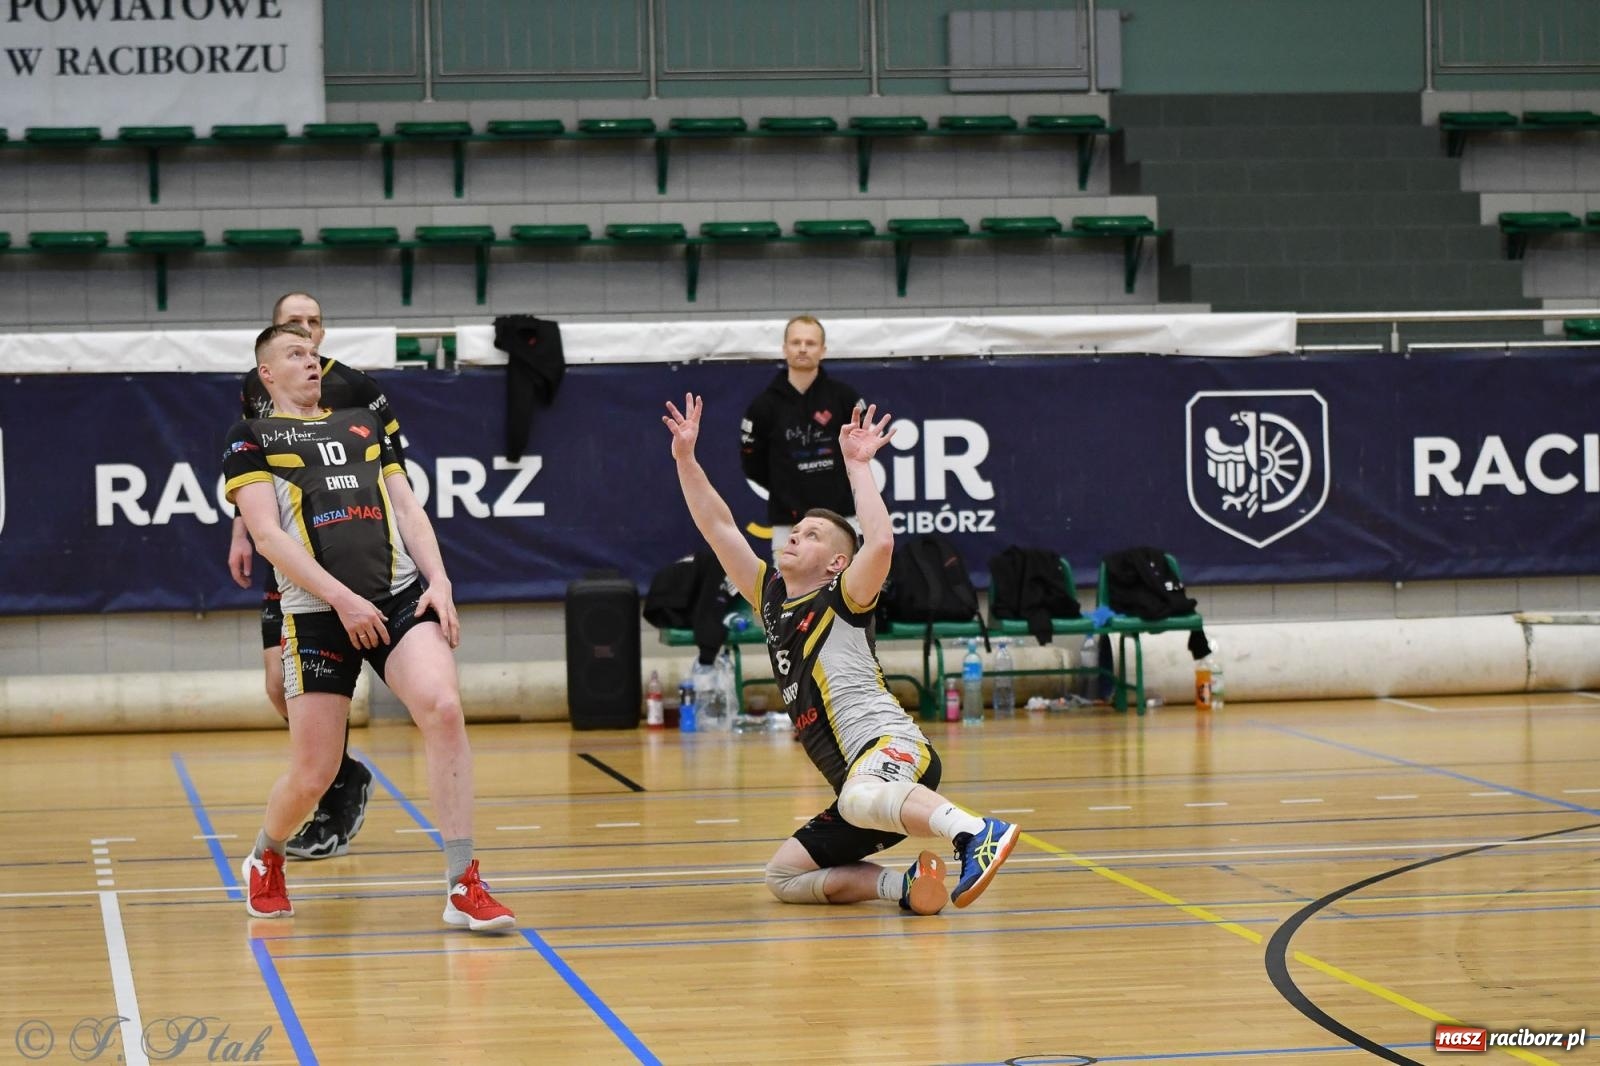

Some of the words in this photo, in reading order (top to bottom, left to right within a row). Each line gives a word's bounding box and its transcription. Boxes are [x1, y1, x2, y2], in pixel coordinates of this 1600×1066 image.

[4, 47, 42, 76] W
[56, 44, 288, 76] RACIBORZU
[317, 441, 348, 466] 10
[325, 474, 359, 491] ENTER
